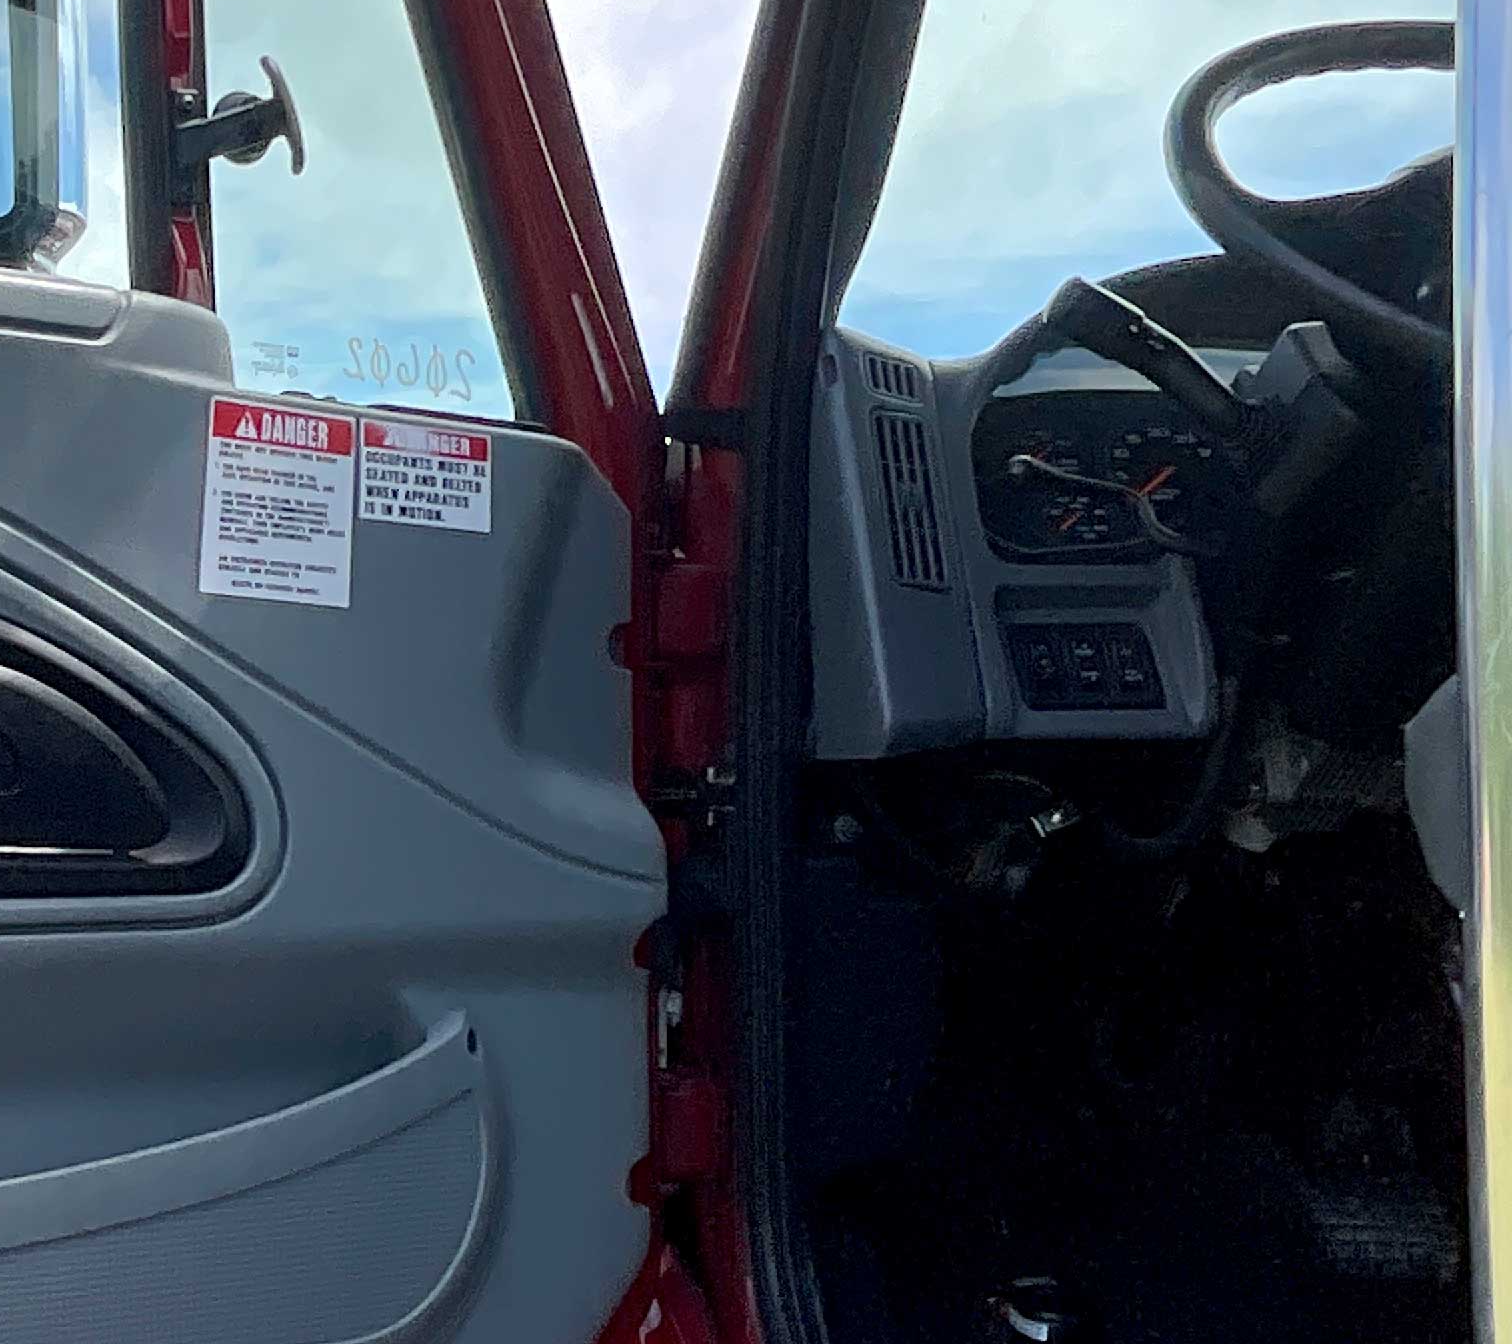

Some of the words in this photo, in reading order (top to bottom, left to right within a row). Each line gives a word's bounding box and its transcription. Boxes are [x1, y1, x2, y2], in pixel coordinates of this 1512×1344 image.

[260, 412, 329, 451] DANGER
[366, 450, 434, 470] OCCUPANTS
[438, 460, 468, 475] MUST
[366, 466, 409, 484] SEATED
[414, 474, 438, 487] AND
[442, 476, 482, 493] BELTED
[364, 501, 376, 514] IS
[381, 503, 393, 515] IN
[366, 485, 400, 500] WHEN
[405, 490, 469, 508] APPARATUS
